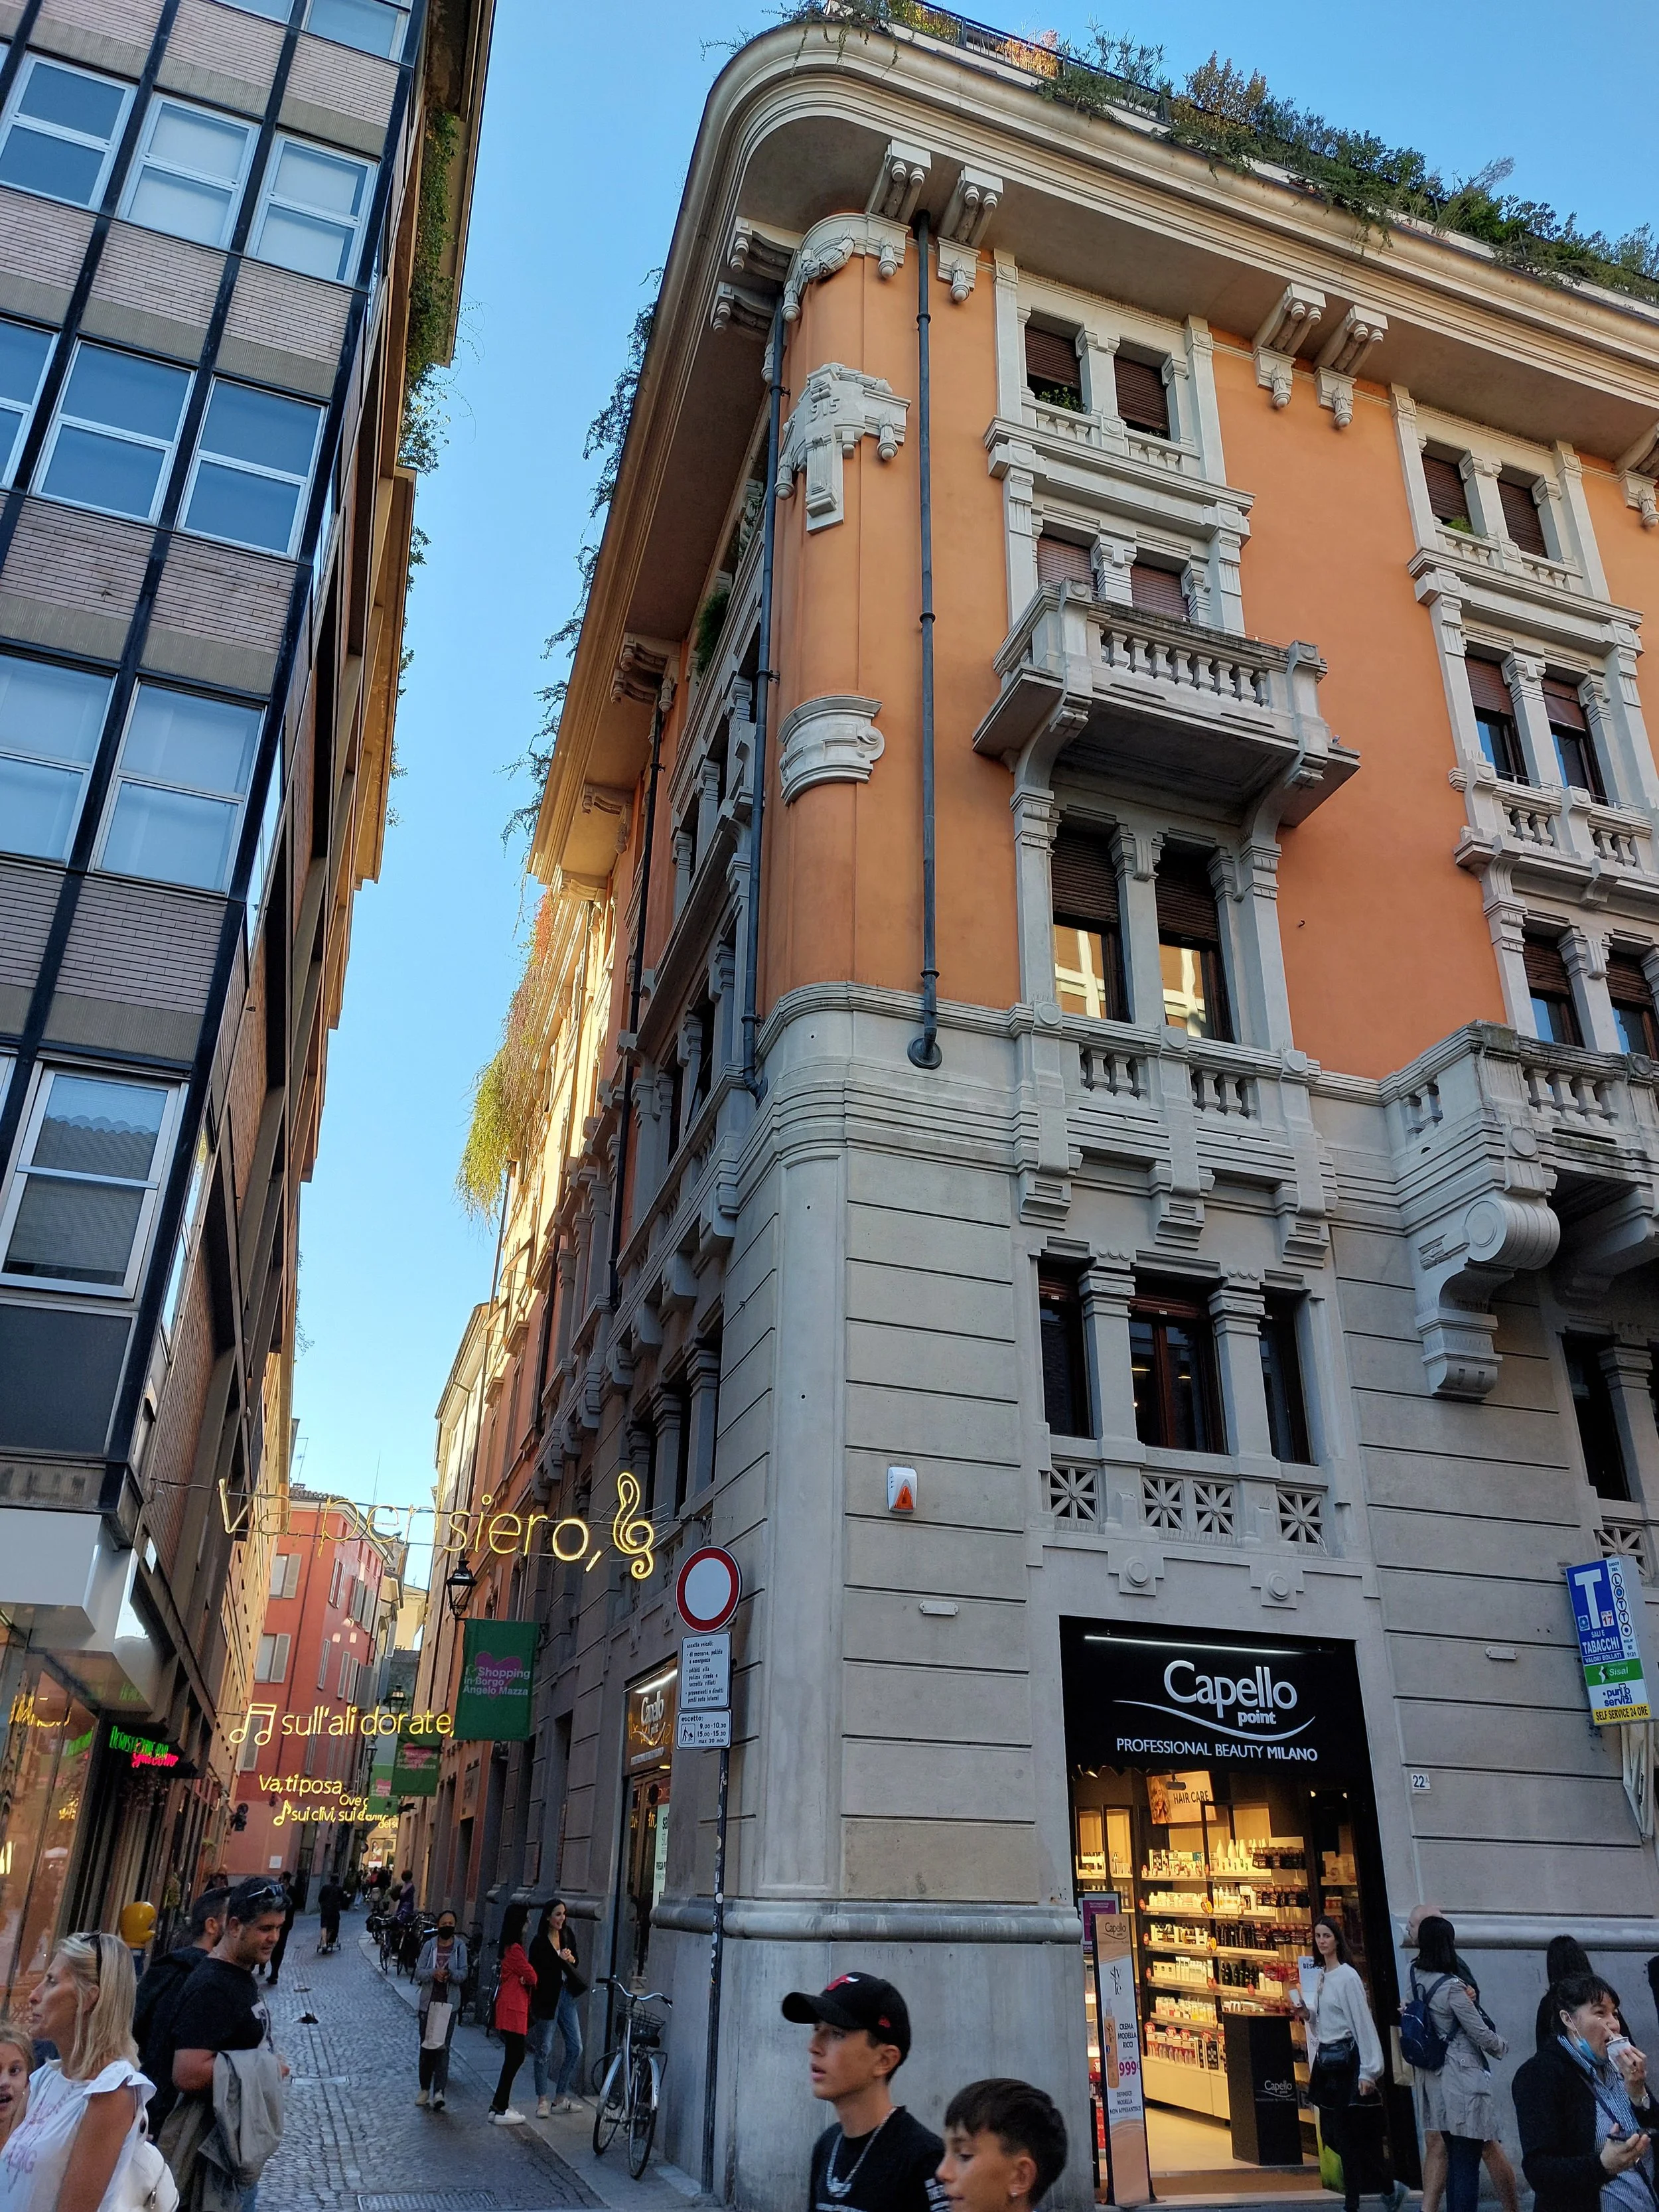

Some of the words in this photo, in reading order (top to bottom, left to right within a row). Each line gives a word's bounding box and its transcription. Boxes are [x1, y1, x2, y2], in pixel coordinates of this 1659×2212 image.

[317, 1493, 601, 1572] pensiero,
[1573, 1568, 1602, 1629] T
[1603, 1616, 1613, 1625] 17
[1591, 1630, 1601, 1639] SALI
[1582, 1636, 1620, 1655] TABACCHI
[1602, 1653, 1622, 1661] BOLLATI
[478, 1667, 531, 1680] Shopping
[1609, 1666, 1628, 1676] Sisal
[464, 1676, 472, 1685] in
[475, 1676, 504, 1688] Borgo
[1163, 1660, 1297, 1718] Capello
[463, 1685, 496, 1695] Angelo
[499, 1686, 528, 1696] Mazza
[1604, 1694, 1633, 1707] servizi
[281, 1704, 357, 1736] sull'ali
[360, 1706, 455, 1737] dorate,
[1238, 1710, 1277, 1727] point
[1595, 1710, 1607, 1721] SELF
[1608, 1708, 1630, 1720] SERVICE
[1630, 1708, 1637, 1716] 24
[1637, 1706, 1648, 1716] ORE
[1116, 1737, 1212, 1756] PROFESSIONAL
[1215, 1743, 1263, 1759] BEAUTY
[1267, 1746, 1318, 1762] MILANO
[259, 1773, 283, 1794] Va,
[285, 1773, 299, 1792] ti
[299, 1779, 342, 1797] posa
[1412, 1775, 1425, 1787] 22
[1173, 1792, 1190, 1805] HAIR
[1190, 1791, 1209, 1803] CARE
[291, 1806, 311, 1822] sui
[311, 1806, 335, 1823] clivi,
[338, 1806, 356, 1822] sui
[1105, 1922, 1127, 1935] Capello
[1264, 2079, 1293, 2093] Capello
